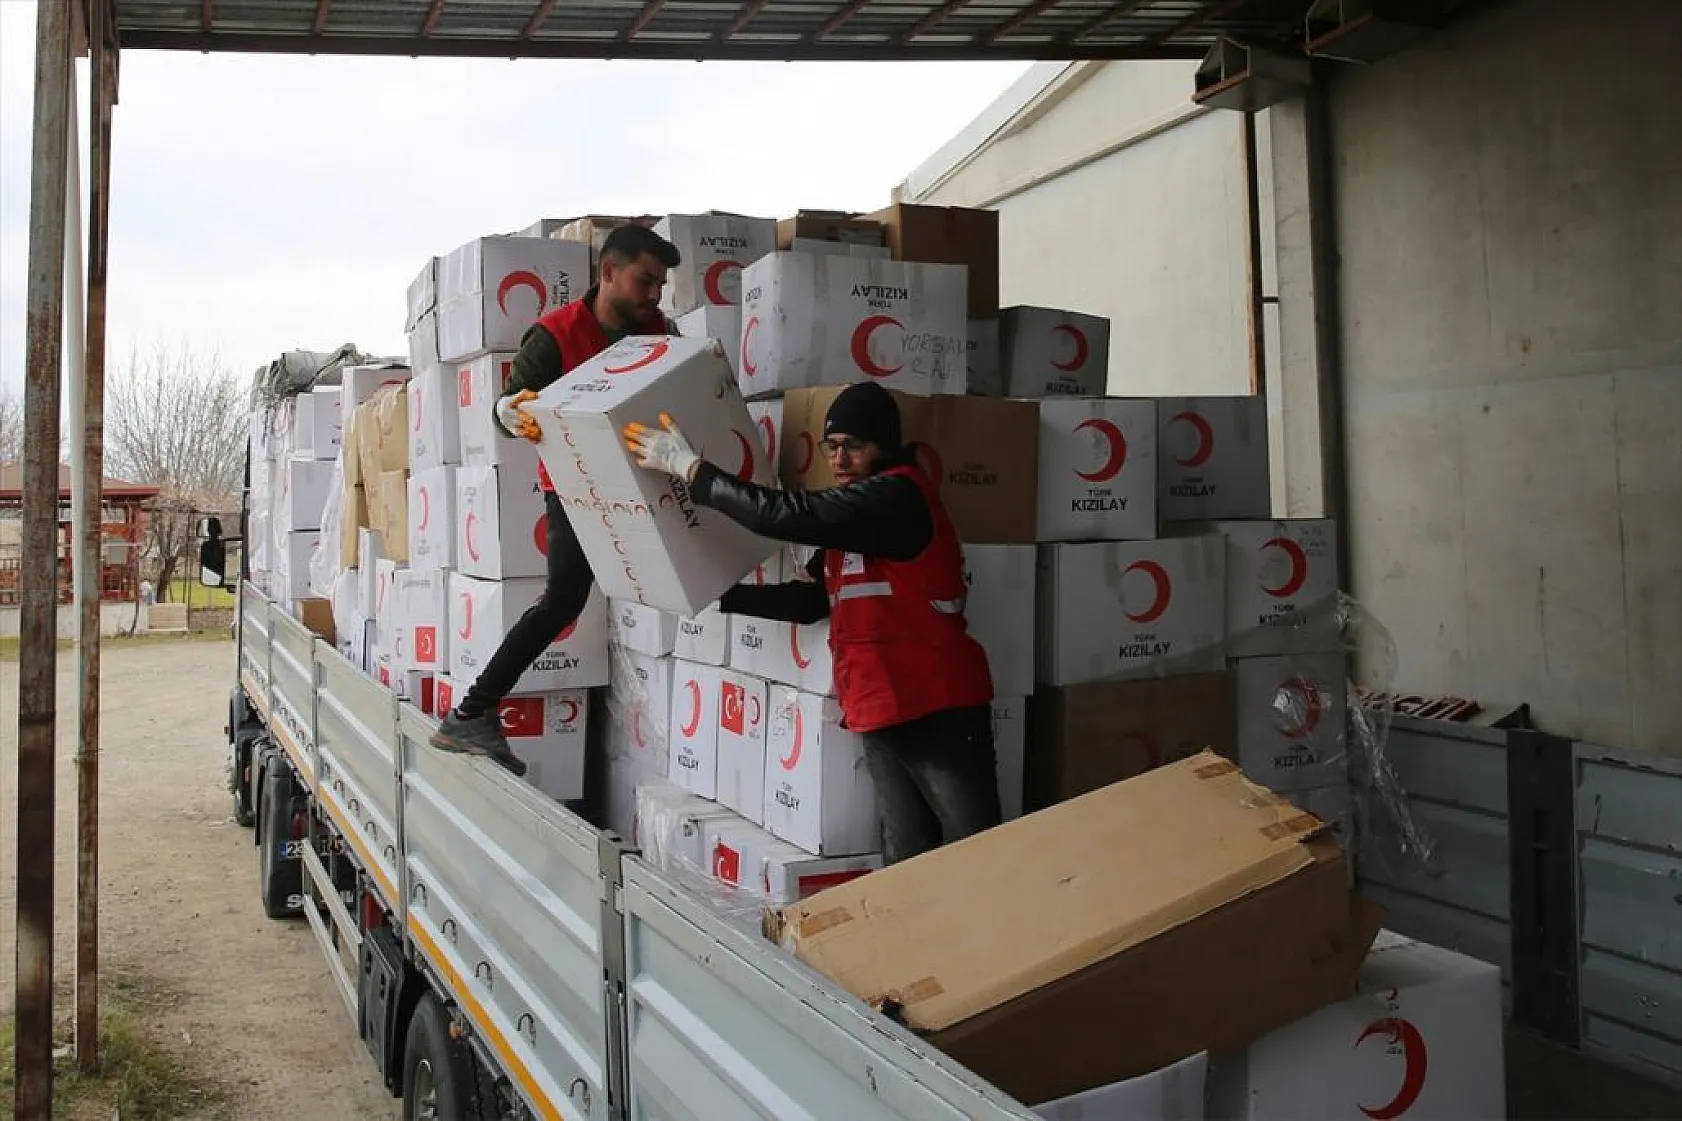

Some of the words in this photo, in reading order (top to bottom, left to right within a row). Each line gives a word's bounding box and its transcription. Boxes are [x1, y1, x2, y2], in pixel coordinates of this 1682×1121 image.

[851, 284, 908, 299] KIZILAY
[949, 470, 998, 485] KIZILAY
[1087, 488, 1112, 496] TÜRK
[1169, 485, 1217, 497] KIZILAY
[1071, 498, 1128, 512] KIZILAY
[1119, 642, 1171, 658] KIZILAY
[532, 658, 580, 671] KIZILAY
